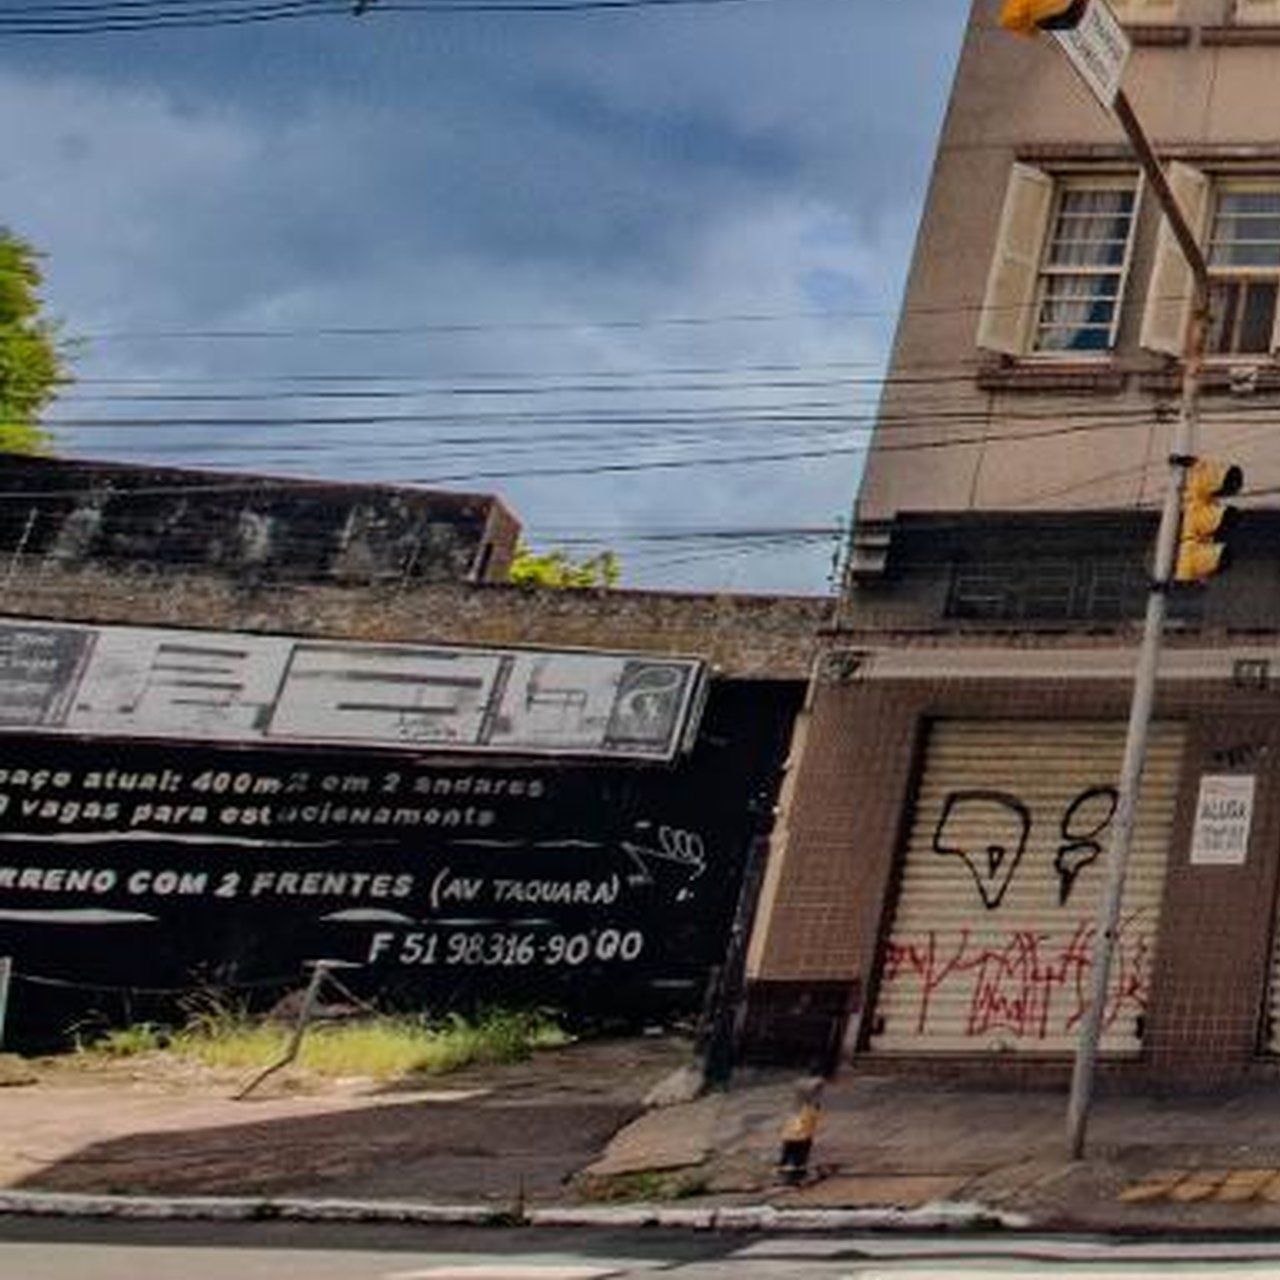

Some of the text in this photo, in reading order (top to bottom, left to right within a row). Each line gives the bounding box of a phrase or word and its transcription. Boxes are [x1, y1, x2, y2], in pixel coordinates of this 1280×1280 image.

[82, 768, 182, 793] atual:
[382, 772, 401, 793] 2
[22, 795, 121, 824] vagas
[130, 802, 209, 826] para
[128, 870, 209, 896] COM
[213, 871, 241, 898] 2
[250, 872, 415, 898] FRENTES
[431, 866, 484, 909] (AV
[492, 873, 622, 905] TAQUARA)
[368, 931, 395, 964] F
